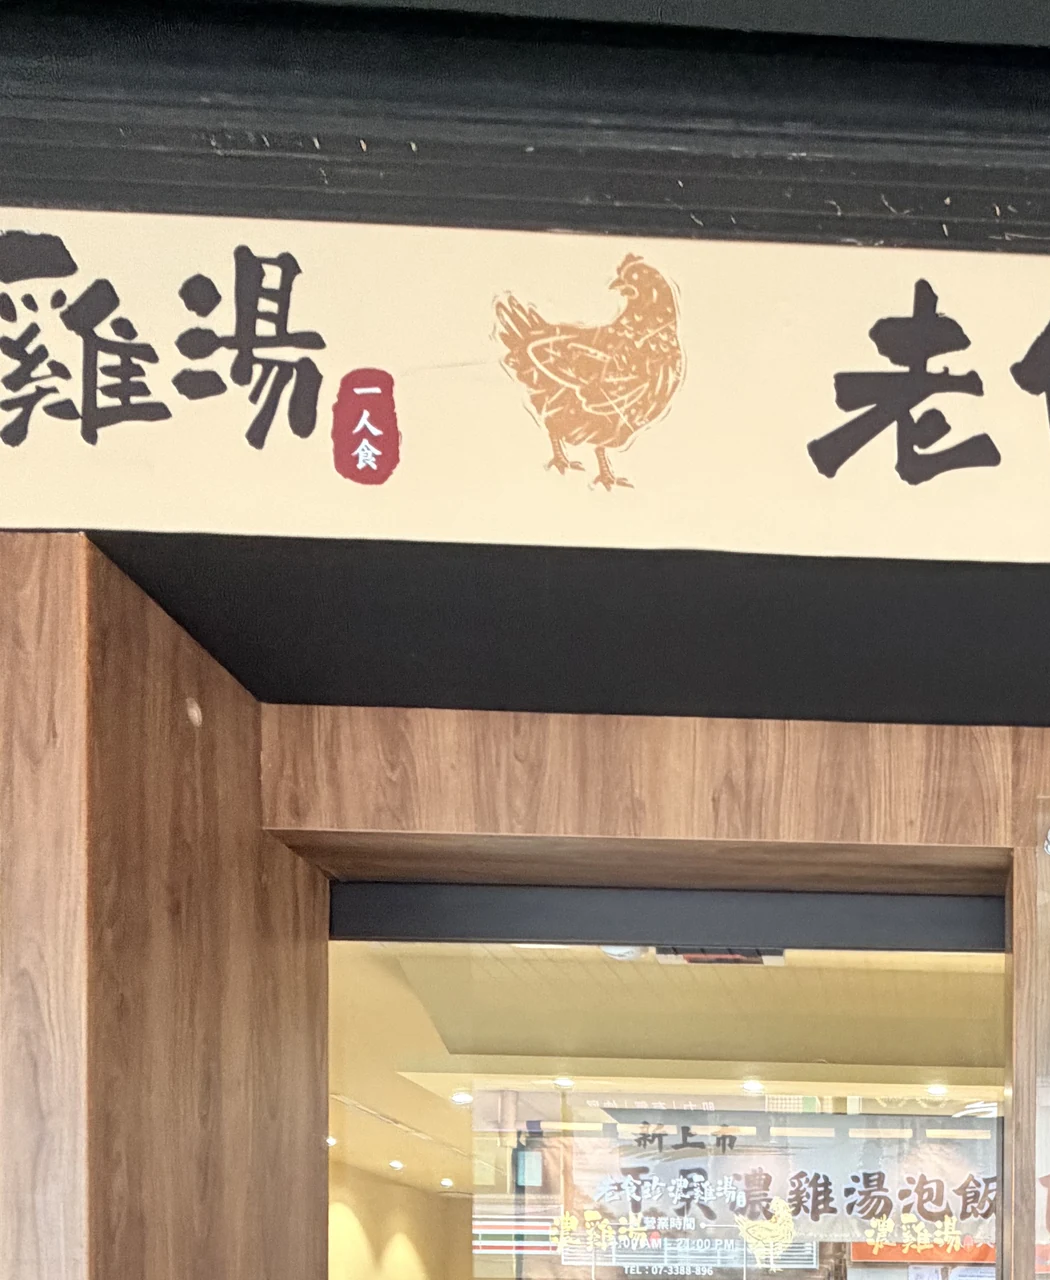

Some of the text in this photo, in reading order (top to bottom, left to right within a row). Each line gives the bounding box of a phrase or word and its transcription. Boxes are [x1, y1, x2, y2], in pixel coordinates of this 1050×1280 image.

[0, 230, 326, 448] 雞湯
[351, 386, 383, 471] 一人食
[632, 1120, 740, 1153] 新上市
[643, 1217, 696, 1231] 營業時間
[864, 1213, 962, 1255] 濃雞湯
